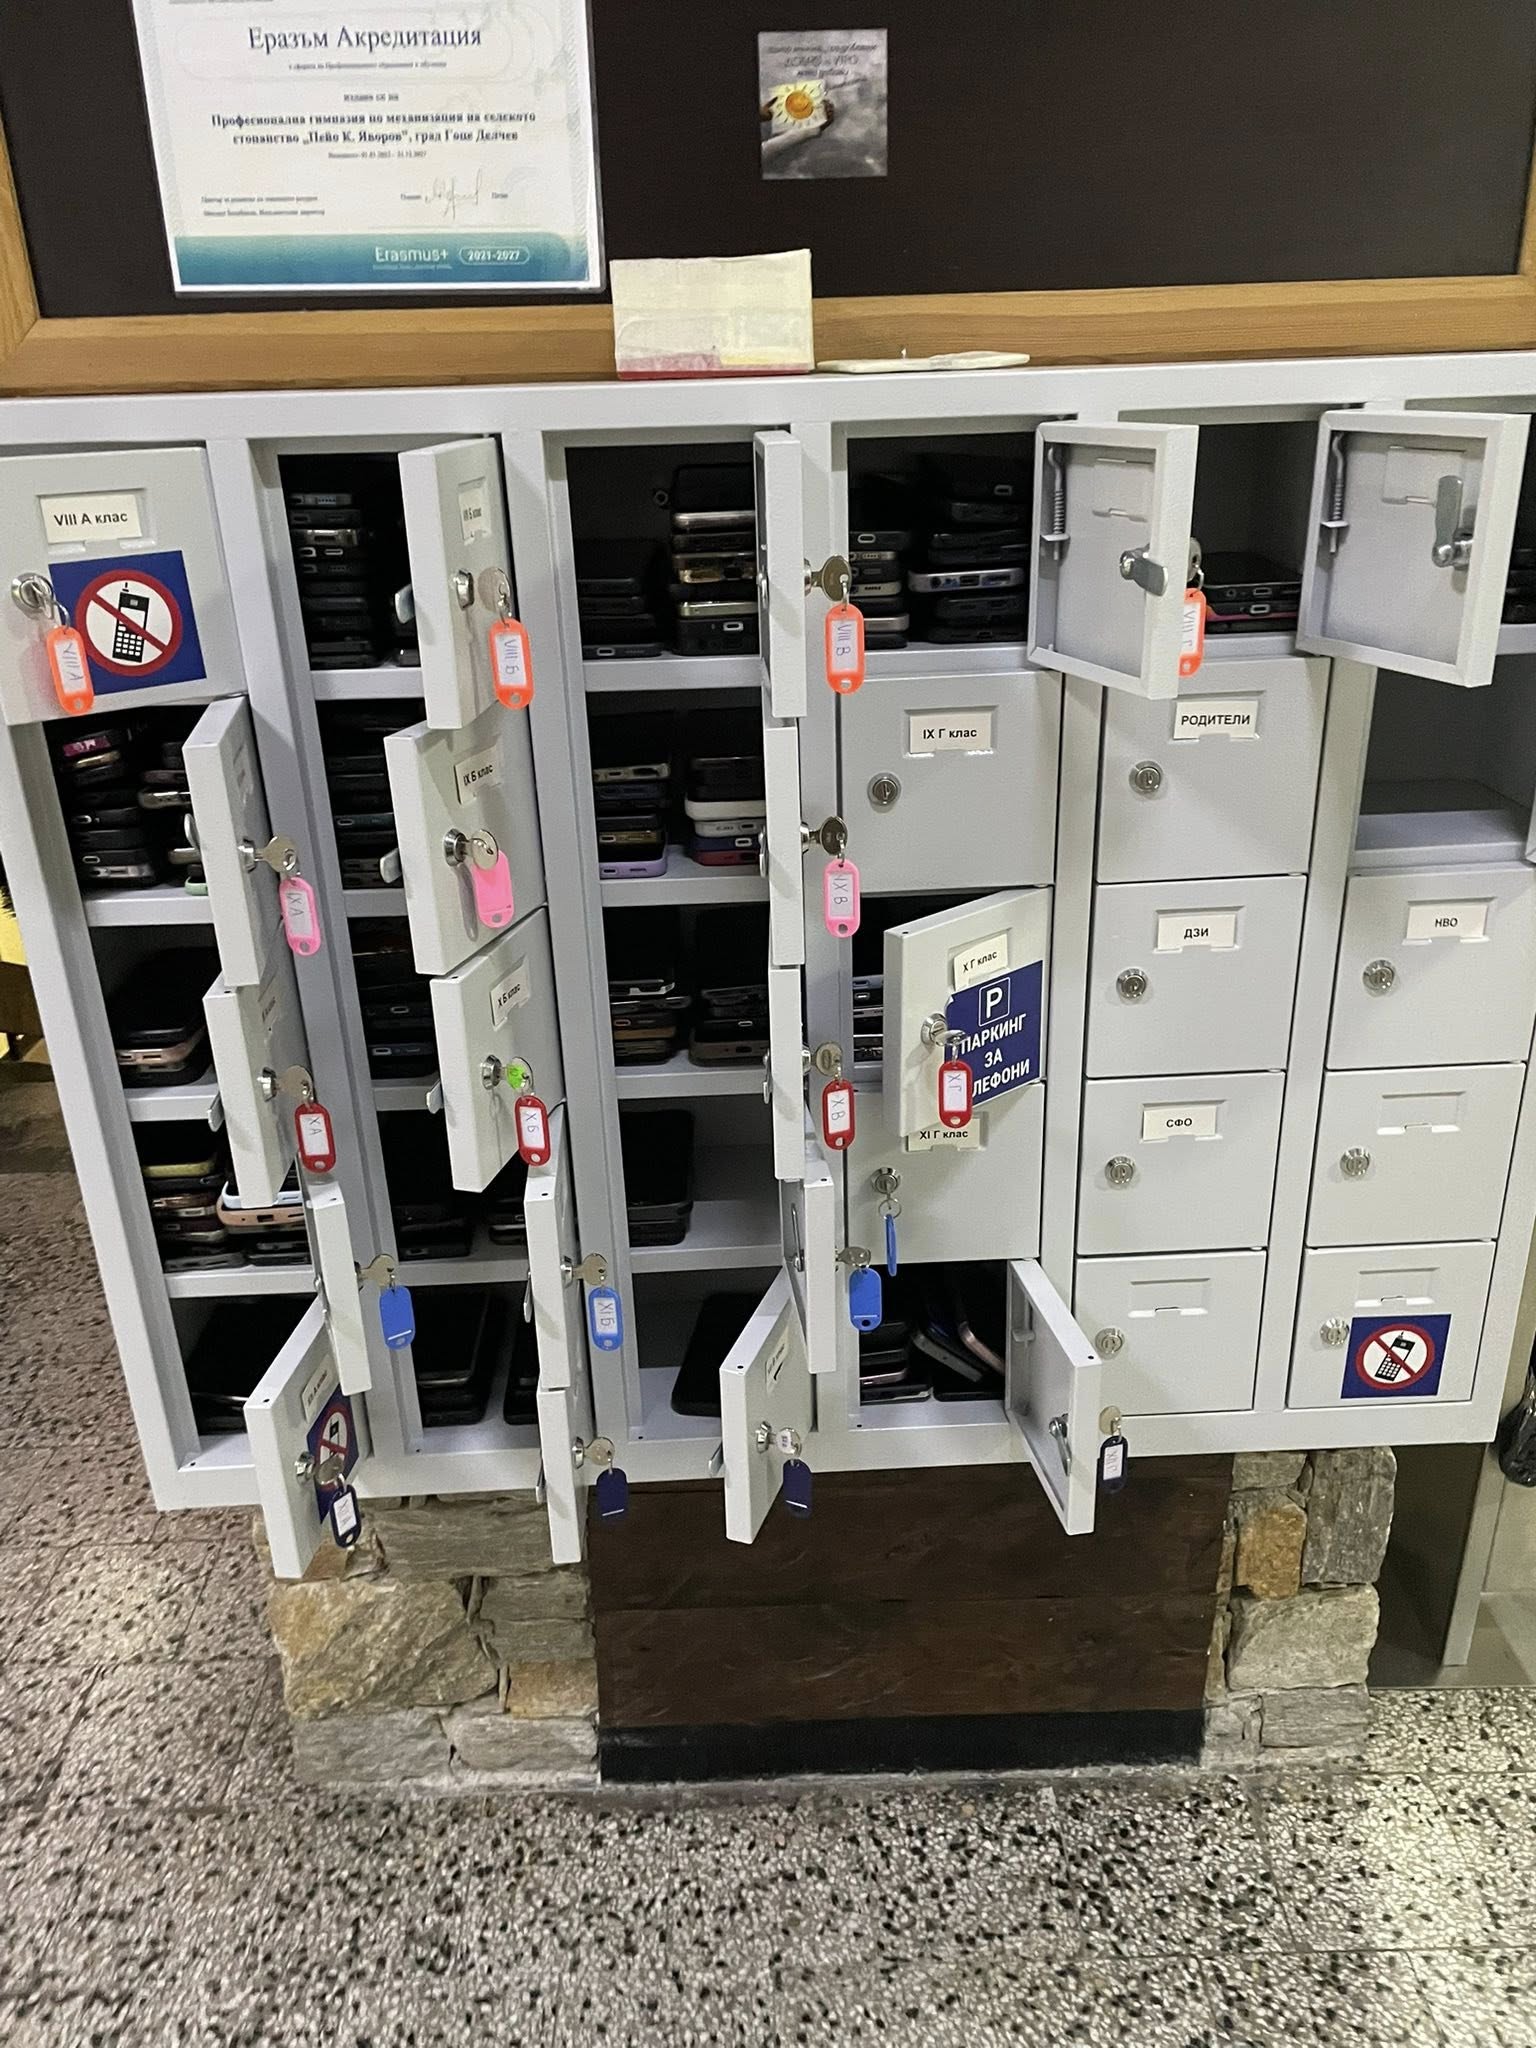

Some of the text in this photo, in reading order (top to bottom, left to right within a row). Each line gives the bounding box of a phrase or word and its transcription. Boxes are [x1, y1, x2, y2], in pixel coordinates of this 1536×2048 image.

[248, 26, 482, 54] Еразъм Акредитация
[212, 112, 536, 129] Професионална гимназия по механизация на селското
[233, 134, 299, 145] стопанство
[415, 131, 441, 144] град
[445, 129, 474, 142] Гоце
[476, 129, 518, 143] Делчев
[375, 247, 520, 262] Erasmus+ 2021-2027
[54, 512, 128, 527] VIII А клас
[1181, 714, 1250, 727] РОДИТЕЛИ
[923, 728, 978, 739] IX Г клас
[477, 764, 493, 779] клас
[1434, 917, 1458, 928] НВО
[1184, 927, 1209, 939] ДЗИ
[970, 958, 976, 970] Г
[977, 951, 998, 966] клас
[986, 987, 1003, 1019] P
[961, 1013, 1026, 1055] ПАРКИНГ
[985, 1048, 1002, 1068] ЗА
[972, 1058, 1030, 1098] ЛЕФОНИ
[1166, 1117, 1192, 1128] СФО
[920, 1130, 968, 1140] XI Г клас
